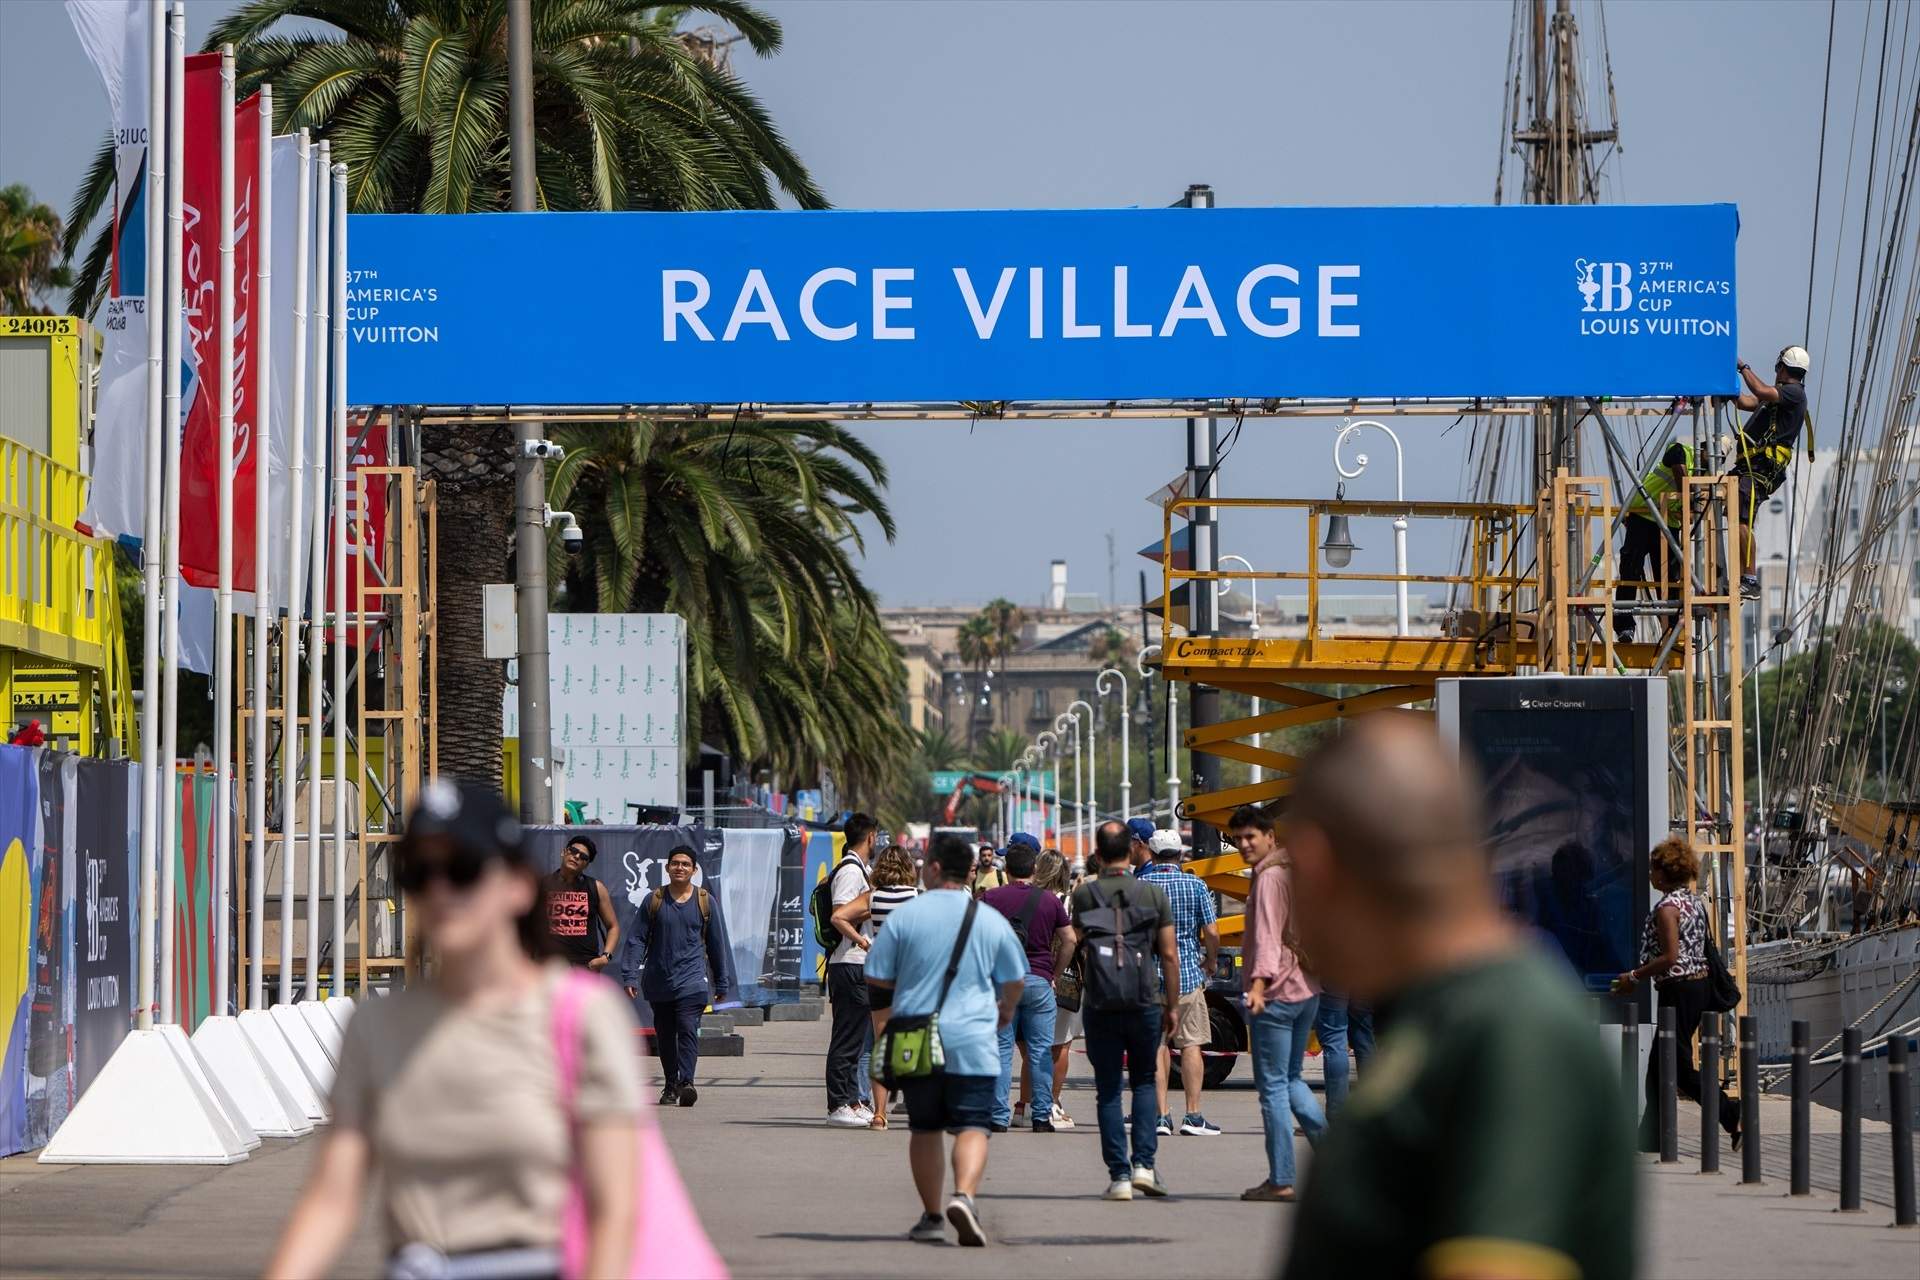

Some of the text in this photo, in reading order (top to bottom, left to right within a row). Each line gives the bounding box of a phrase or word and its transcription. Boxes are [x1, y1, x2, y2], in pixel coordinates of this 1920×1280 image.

[1639, 261, 1673, 275] 37TH
[1639, 280, 1730, 295] AMERICA'S
[346, 288, 438, 302] AMERICA'S
[661, 263, 1361, 343] RACE VILLAGE
[1638, 298, 1673, 312] CUP
[346, 307, 379, 320] CUP
[352, 326, 439, 343] VUITTON
[1581, 318, 1730, 337] LOUIS VUITTON
[1177, 640, 1233, 659] Compact
[1531, 699, 1586, 709] Clear Channel
